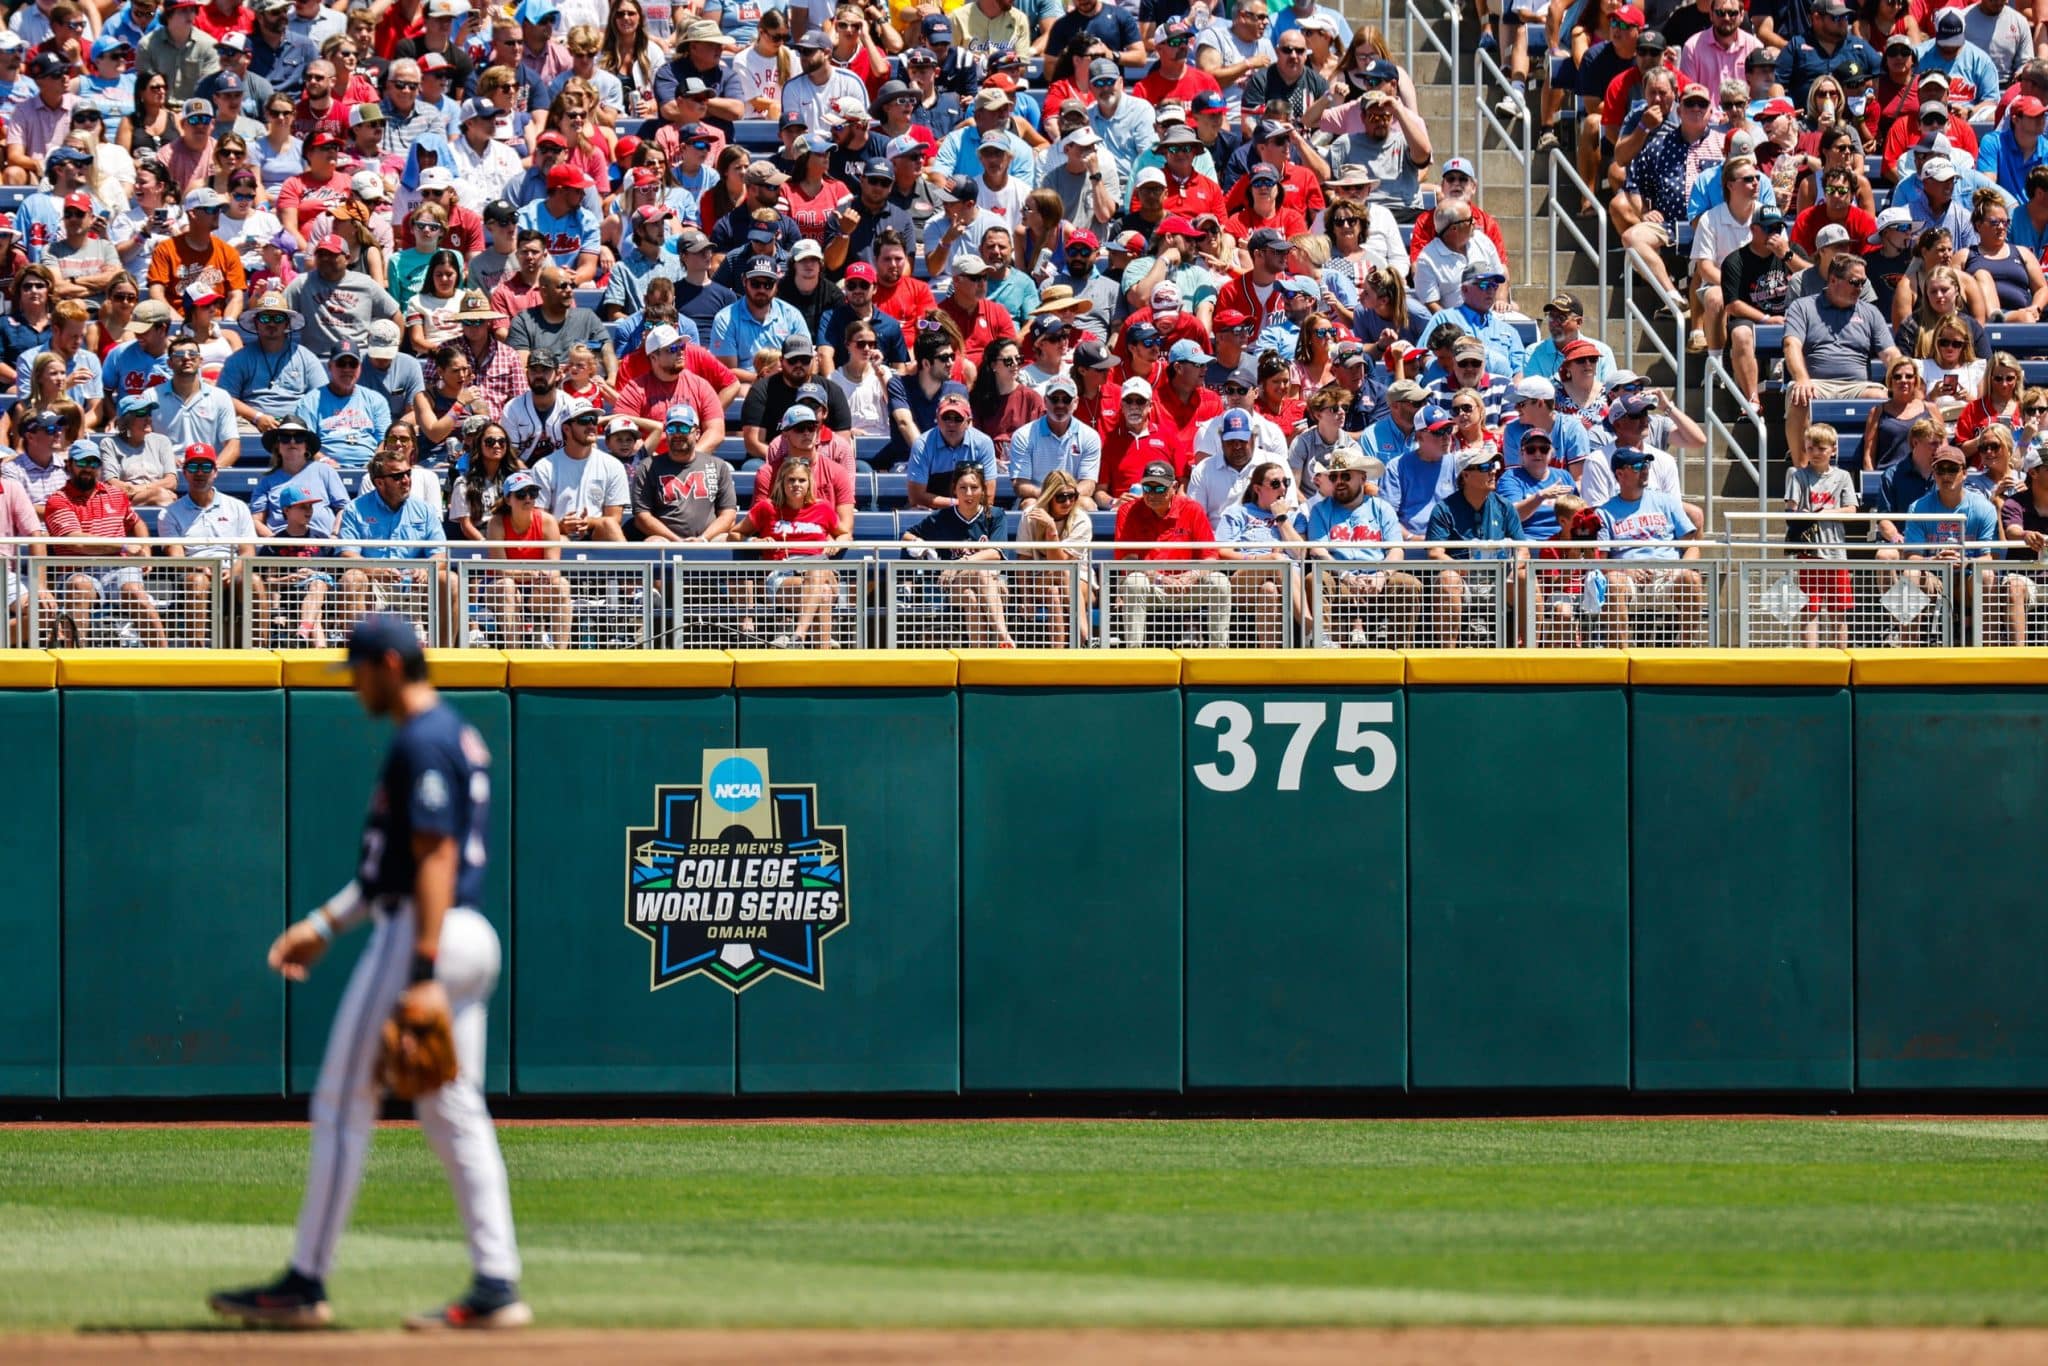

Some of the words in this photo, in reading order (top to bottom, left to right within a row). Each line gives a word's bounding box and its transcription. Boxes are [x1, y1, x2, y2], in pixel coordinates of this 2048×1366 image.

[659, 471, 709, 505] M
[1330, 525, 1350, 541] Ole
[1350, 525, 1382, 542] Miss
[1613, 519, 1635, 535] OLE
[1638, 513, 1667, 528] MISS
[1193, 700, 1397, 792] 375
[714, 783, 761, 799] NCAA
[689, 843, 730, 855] 2022
[735, 842, 783, 855] MEN'S
[676, 858, 797, 888] COLLEGE
[636, 891, 735, 922] WORLD
[739, 890, 839, 921] SERIES
[707, 926, 768, 938] OMAHA
